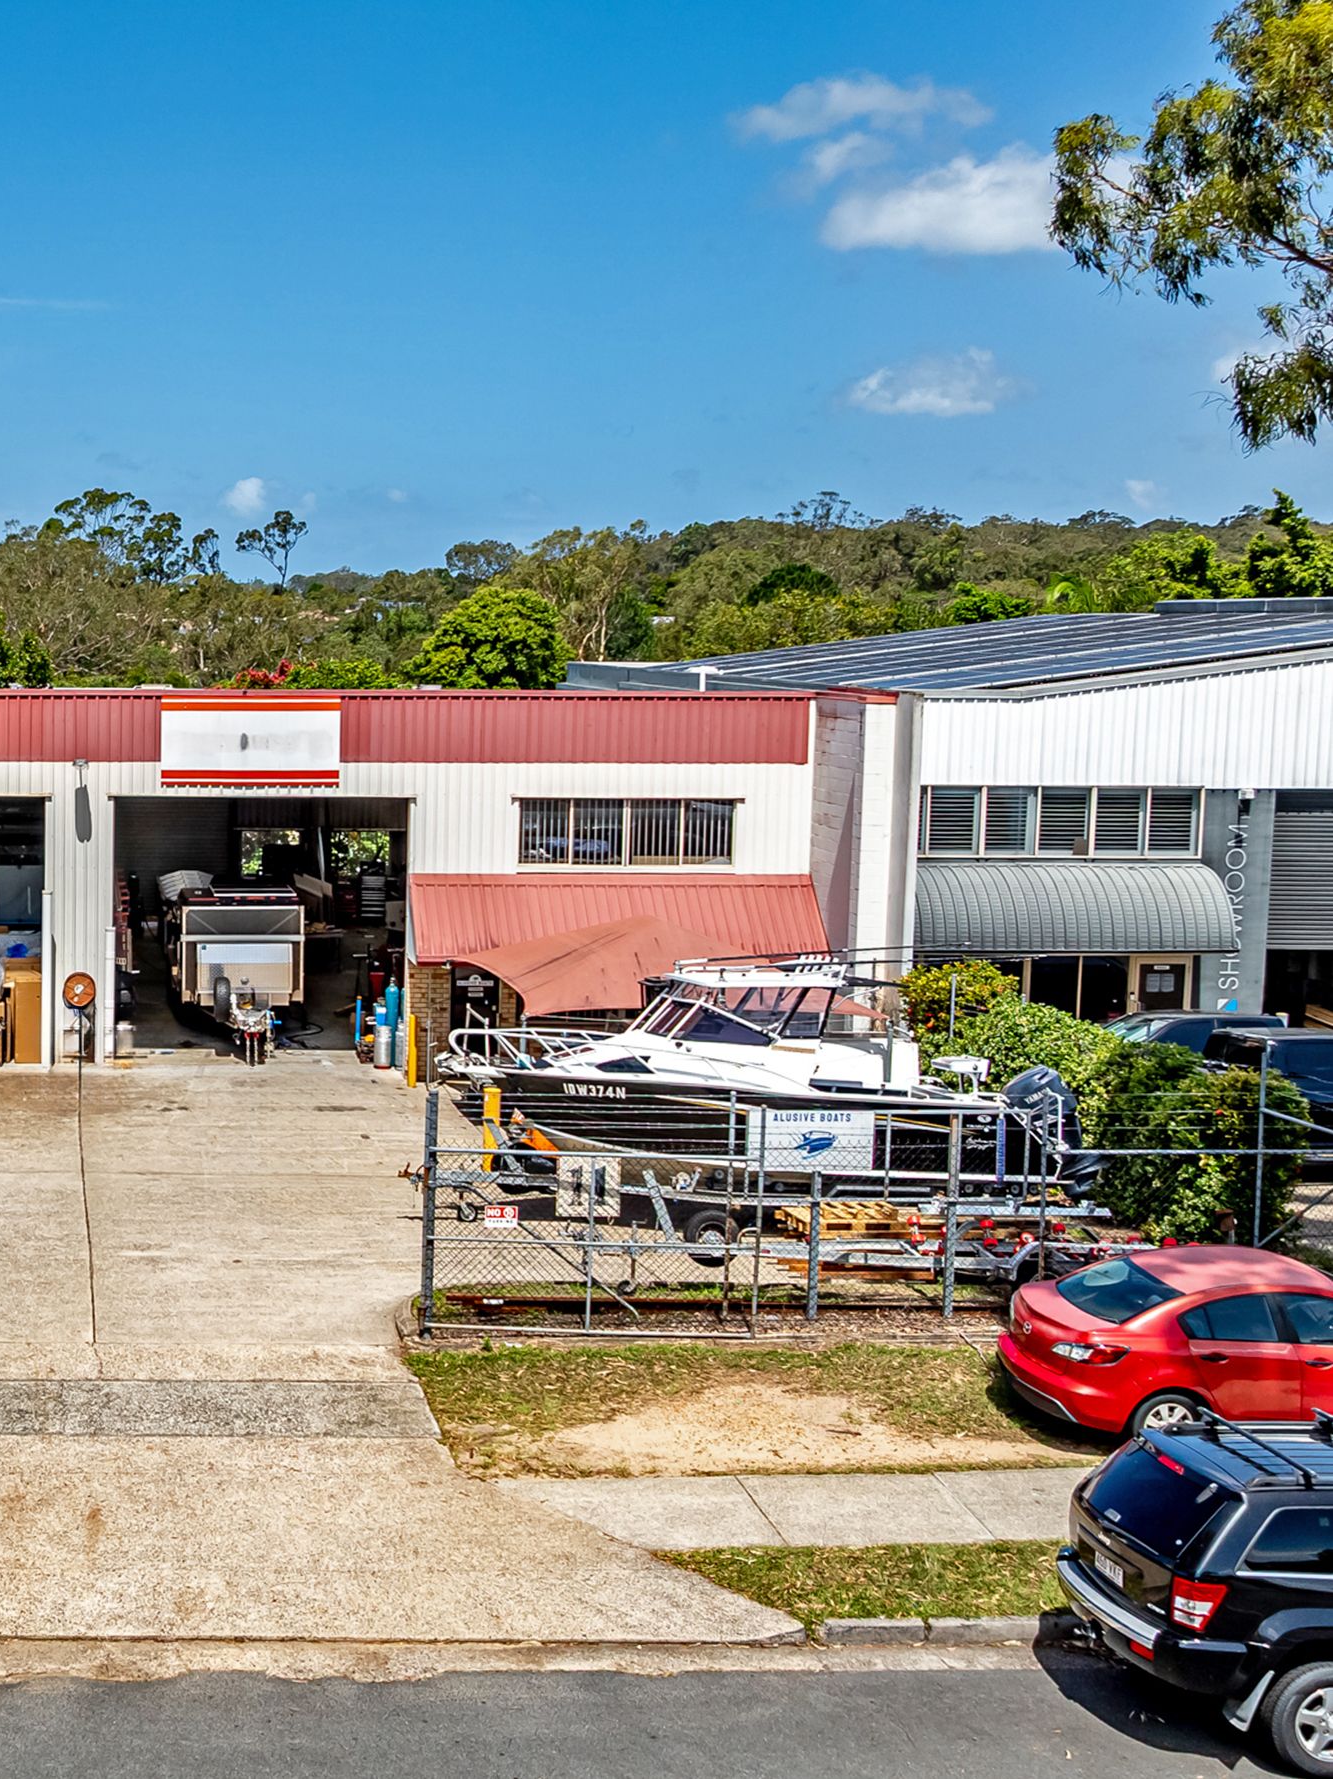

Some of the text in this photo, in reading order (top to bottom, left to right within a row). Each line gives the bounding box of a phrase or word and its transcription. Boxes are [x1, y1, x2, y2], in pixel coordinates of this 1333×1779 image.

[773, 1113, 851, 1122] ALUSIVE BOATS
[487, 1208, 501, 1217] NO
